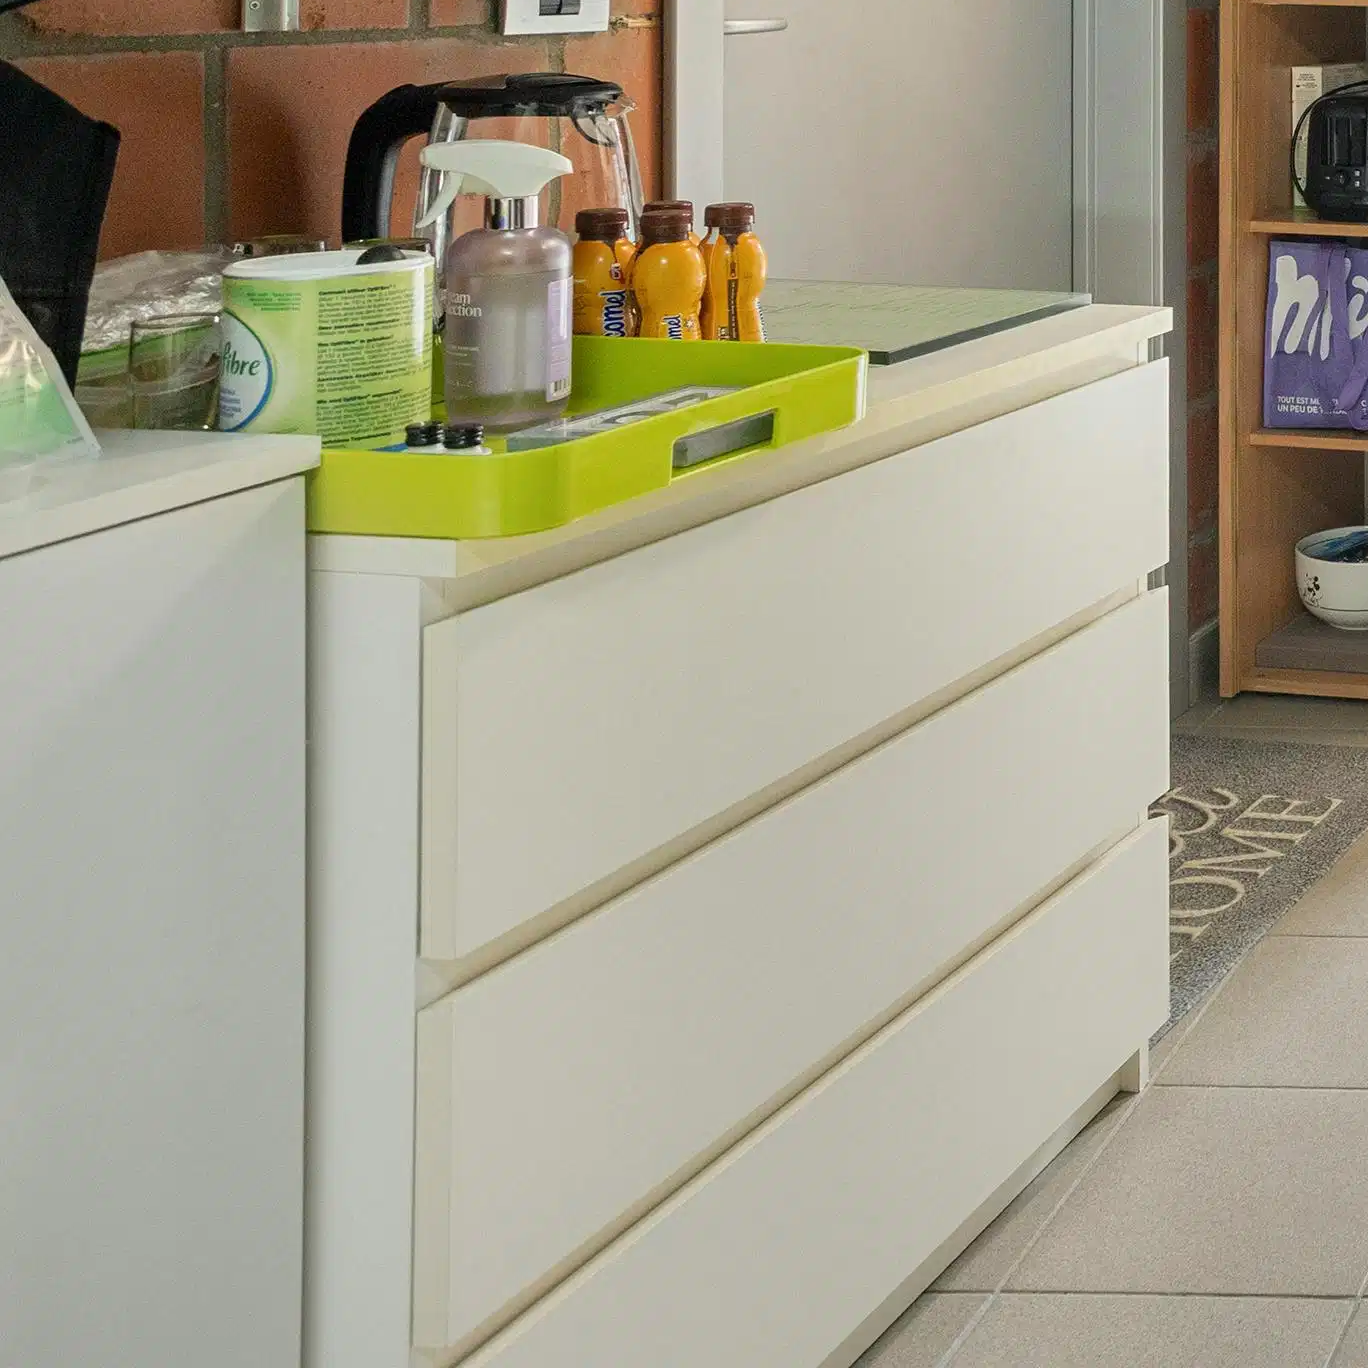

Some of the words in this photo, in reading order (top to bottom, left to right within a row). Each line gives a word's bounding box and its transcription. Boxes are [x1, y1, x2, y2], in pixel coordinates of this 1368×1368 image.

[1277, 396, 1295, 404] TOUT
[1296, 396, 1309, 405] EST
[1277, 405, 1289, 413] UN
[1289, 405, 1305, 413] PEU
